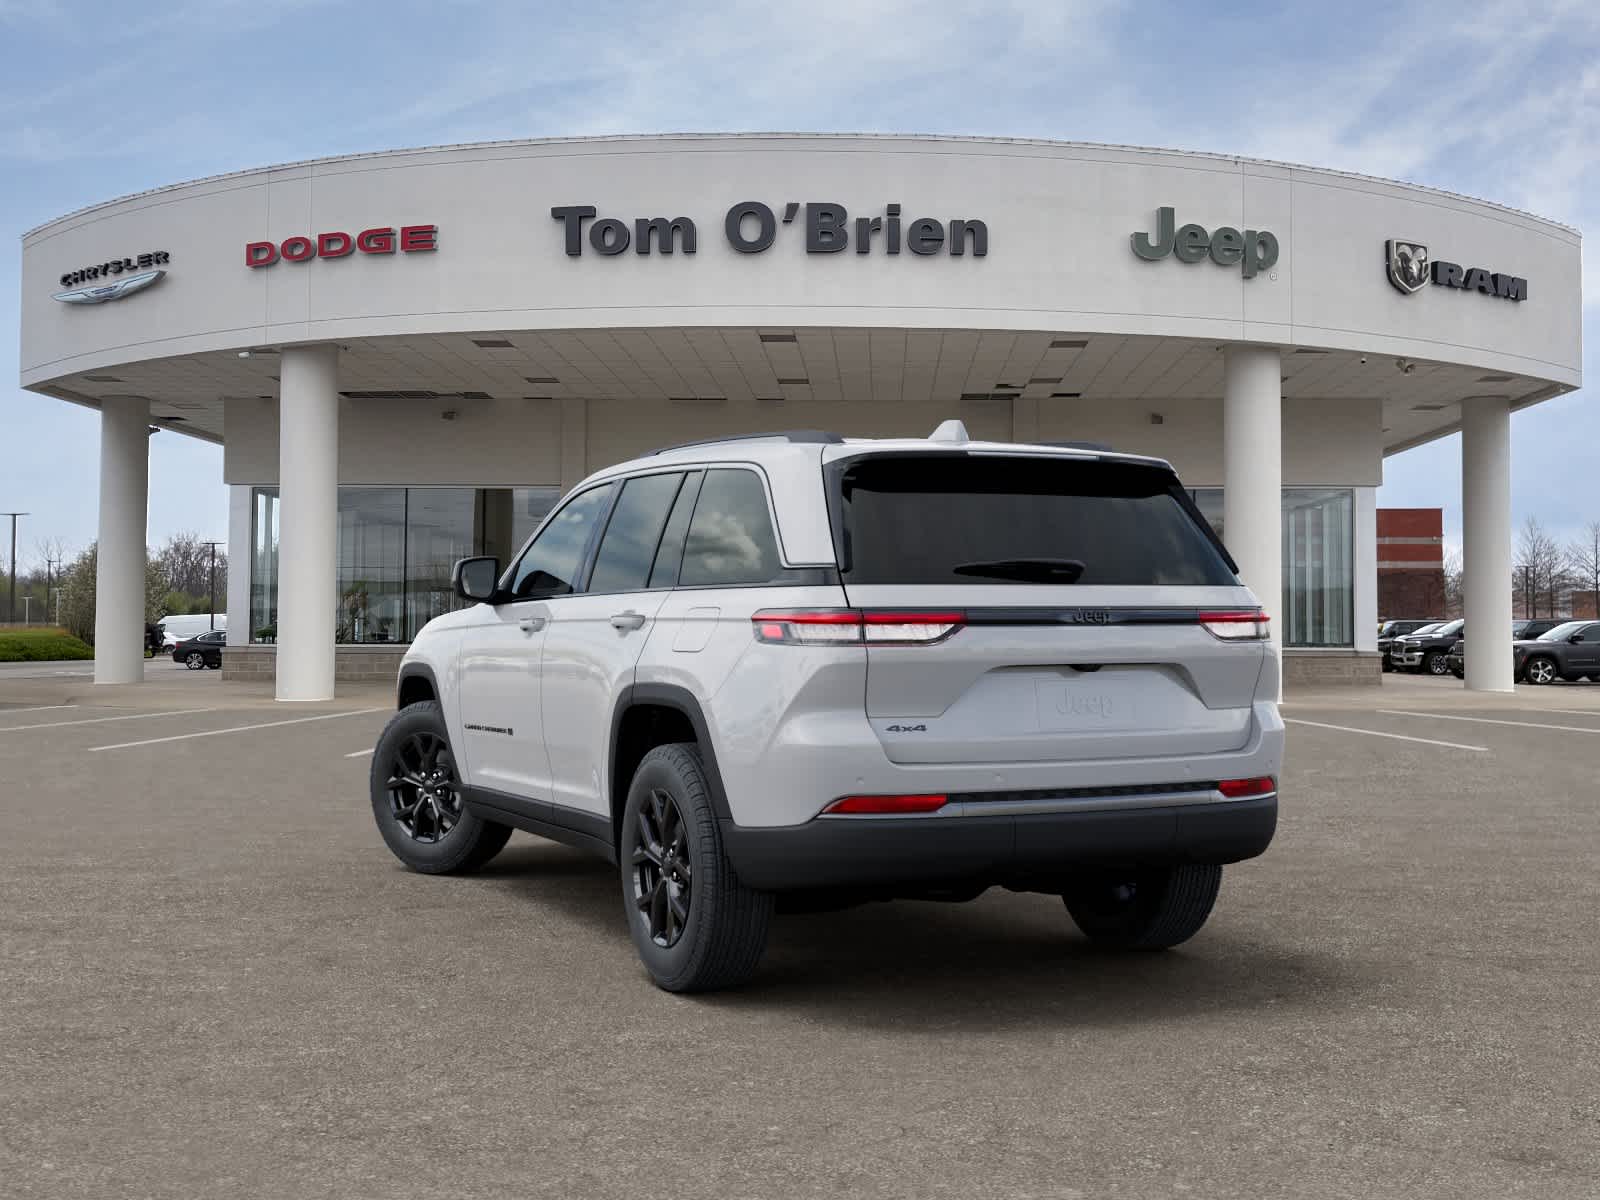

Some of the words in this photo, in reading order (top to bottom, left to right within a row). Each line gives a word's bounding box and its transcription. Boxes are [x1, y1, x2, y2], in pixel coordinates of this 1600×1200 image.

[246, 225, 437, 268] DODGE
[551, 206, 696, 256] Tom
[1130, 207, 1279, 279] Jeep
[60, 250, 170, 286] CHRYSLER
[1431, 261, 1527, 301] RAM
[1071, 608, 1112, 624] Jeep
